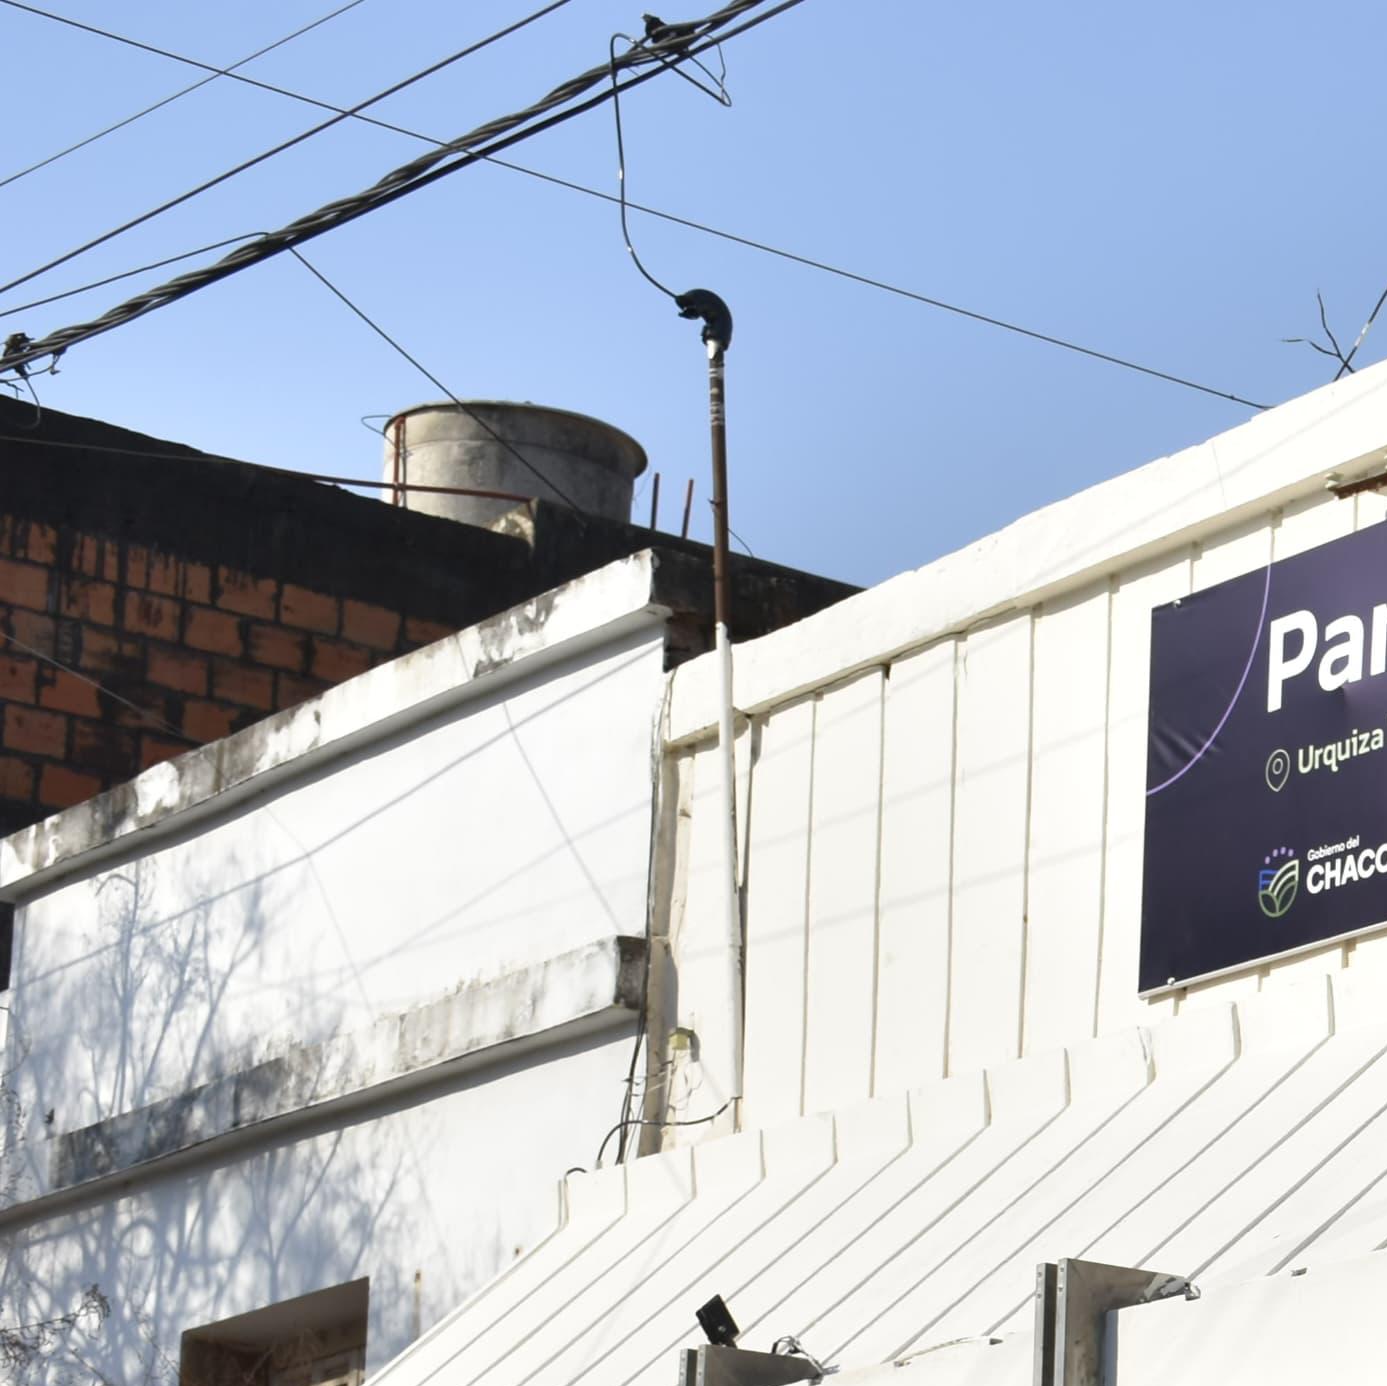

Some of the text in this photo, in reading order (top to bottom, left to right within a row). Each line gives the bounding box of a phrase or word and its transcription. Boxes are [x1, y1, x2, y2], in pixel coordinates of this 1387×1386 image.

[1298, 729, 1385, 773] Urquiza
[1307, 835, 1360, 861] Gobierno del
